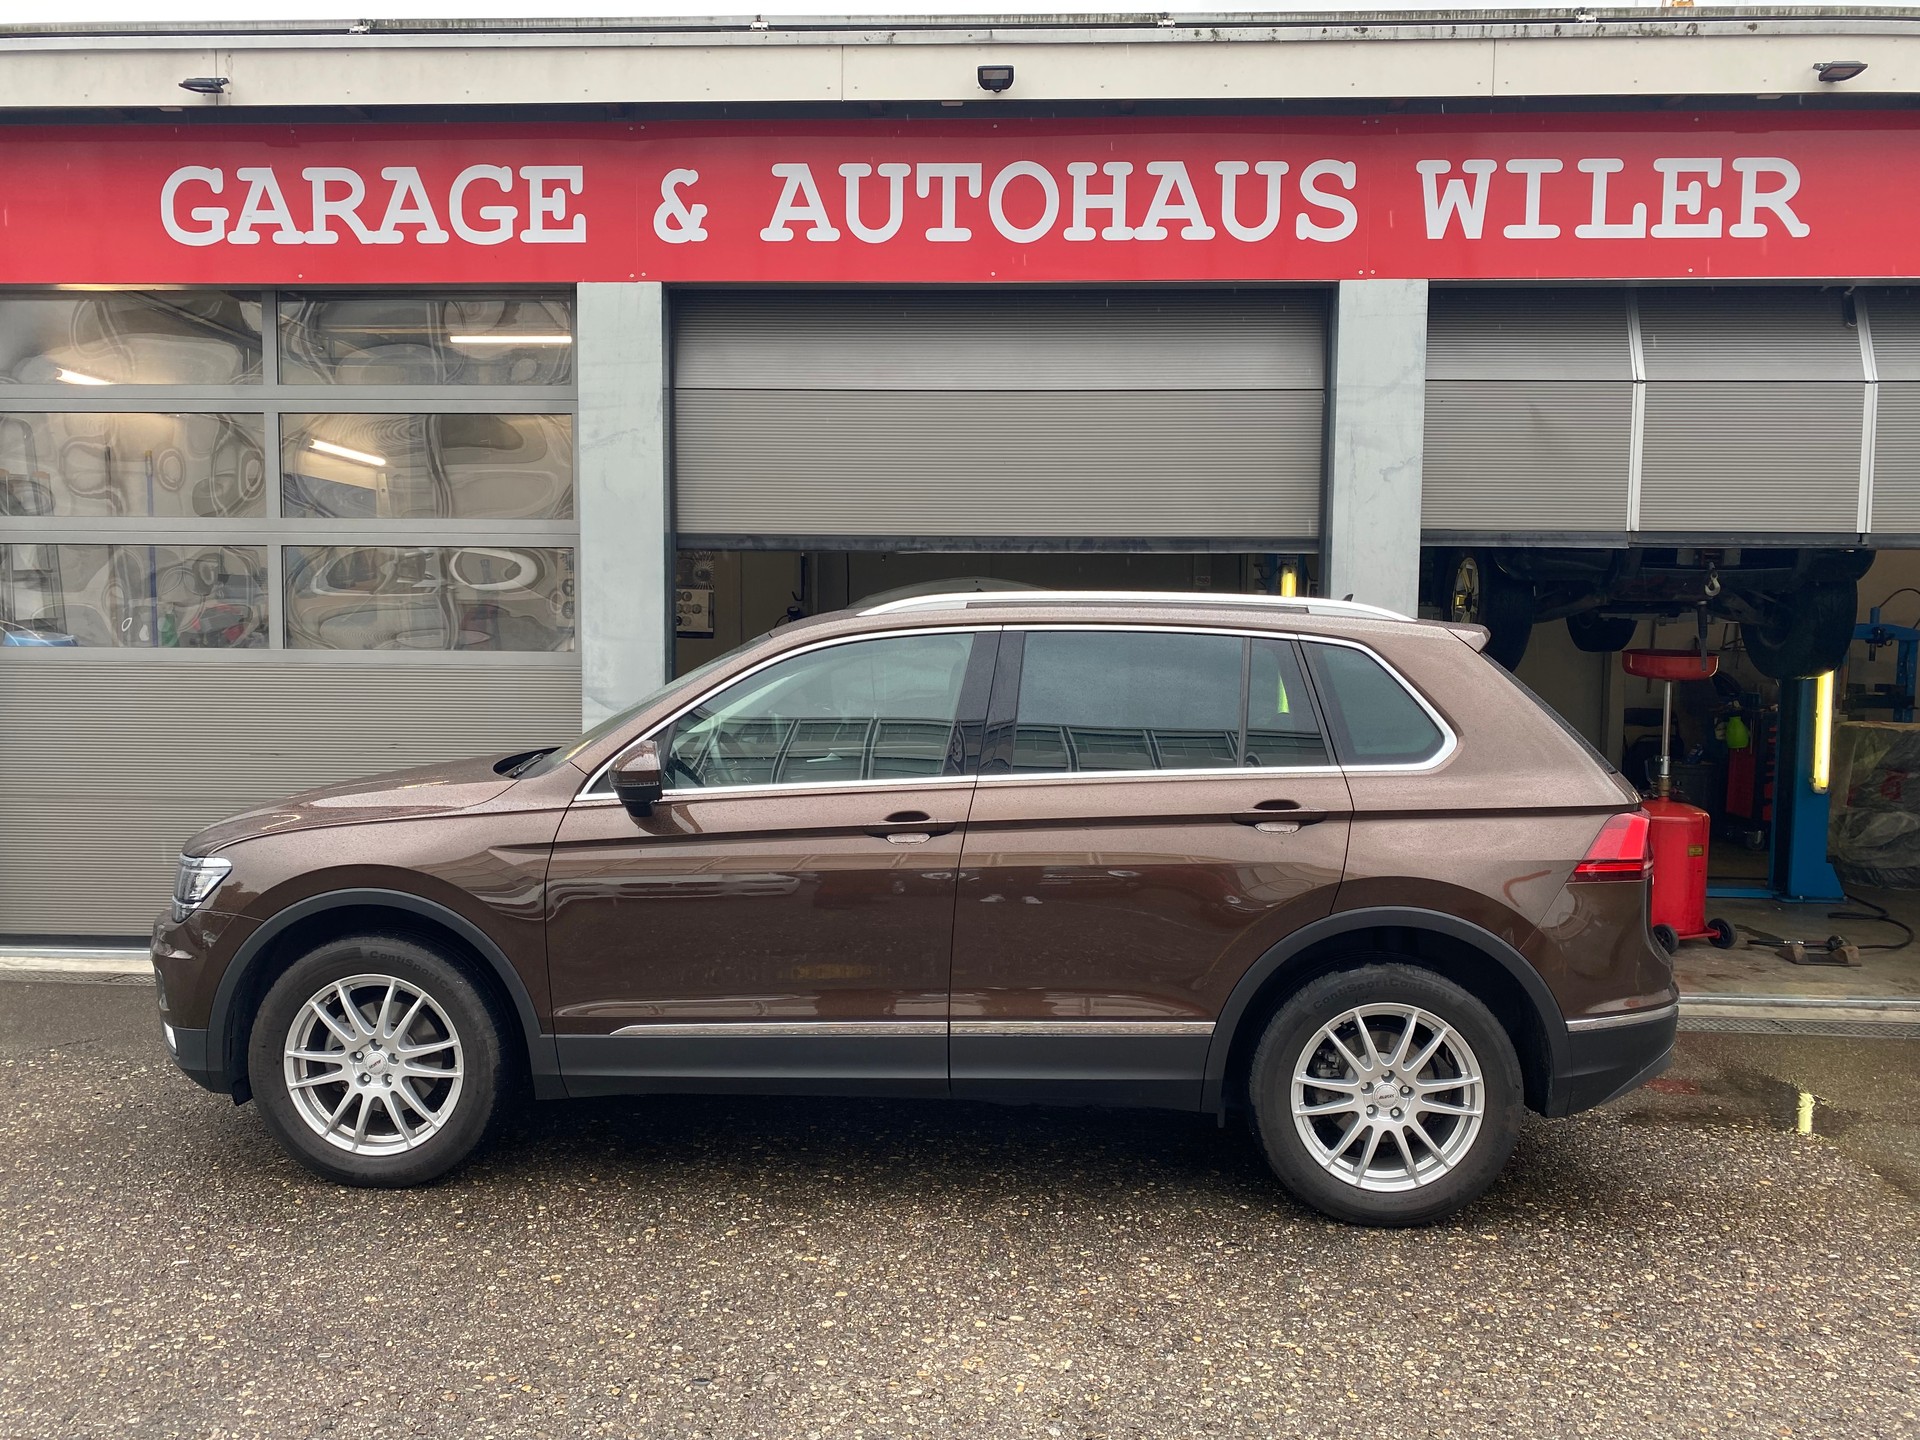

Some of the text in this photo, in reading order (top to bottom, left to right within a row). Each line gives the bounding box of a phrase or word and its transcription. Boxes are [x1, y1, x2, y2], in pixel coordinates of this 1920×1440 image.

[161, 157, 1810, 247] GARAGE & AUTOHAUS WILER
[369, 950, 473, 1023] ContiSportCont
